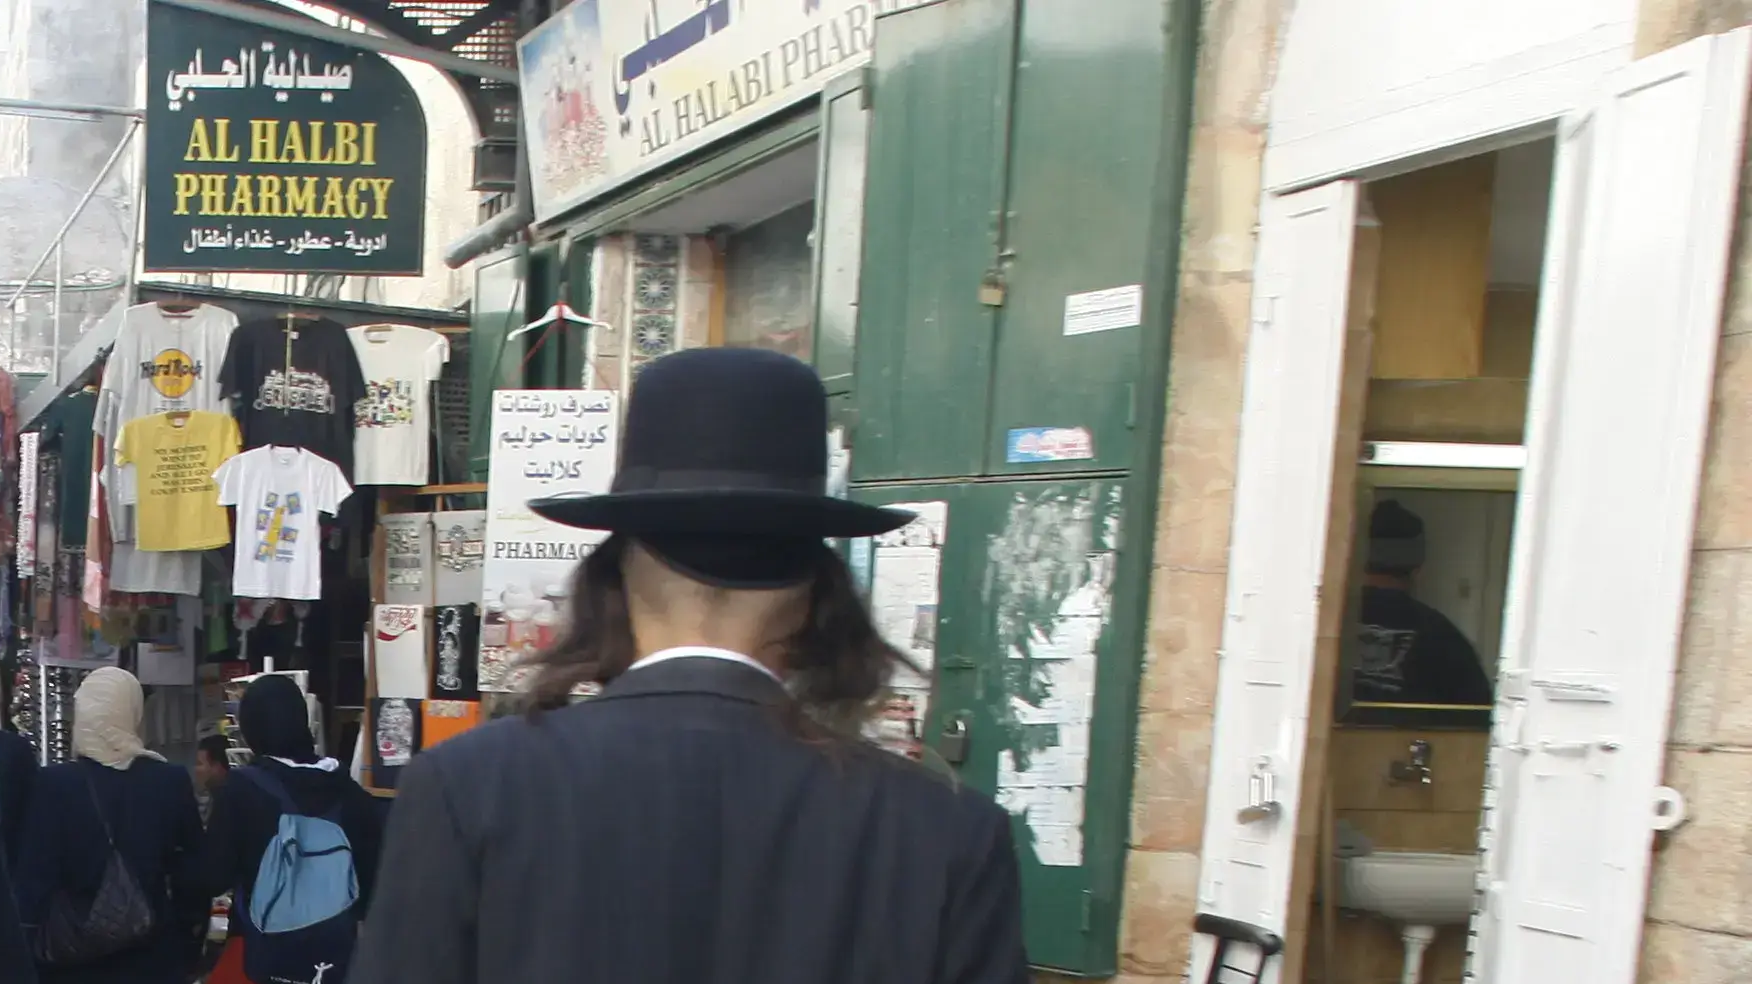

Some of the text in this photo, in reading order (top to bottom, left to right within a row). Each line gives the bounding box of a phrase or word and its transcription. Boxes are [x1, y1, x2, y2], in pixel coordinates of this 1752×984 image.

[166, 41, 353, 112] صيدلية الحلبي
[639, 108, 671, 157] AL
[672, 51, 772, 141] HALABI
[779, 3, 876, 88] PHAR
[183, 118, 377, 166] AL HALBI
[173, 173, 394, 220] PHARMACY
[284, 229, 333, 255] عطور
[492, 541, 601, 561] PHARMAC
